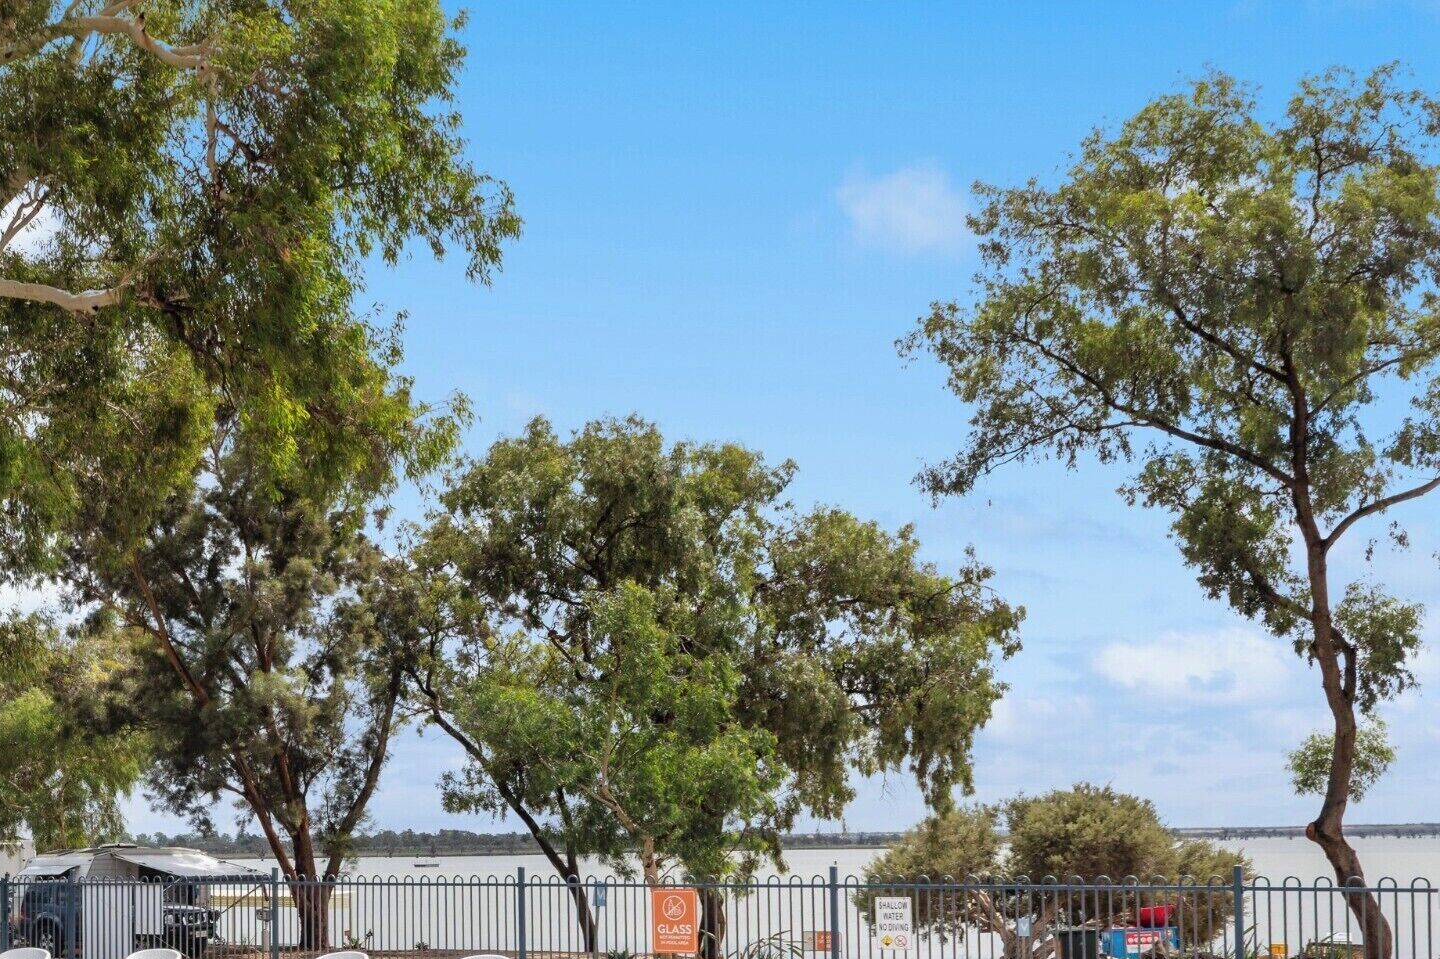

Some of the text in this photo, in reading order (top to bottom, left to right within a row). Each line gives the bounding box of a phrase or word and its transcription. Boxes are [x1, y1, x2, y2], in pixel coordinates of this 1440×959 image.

[879, 901, 908, 910] SHALLOW
[883, 912, 904, 920] WATER
[657, 924, 692, 934] GLASS
[879, 923, 909, 931] NO DIVING
